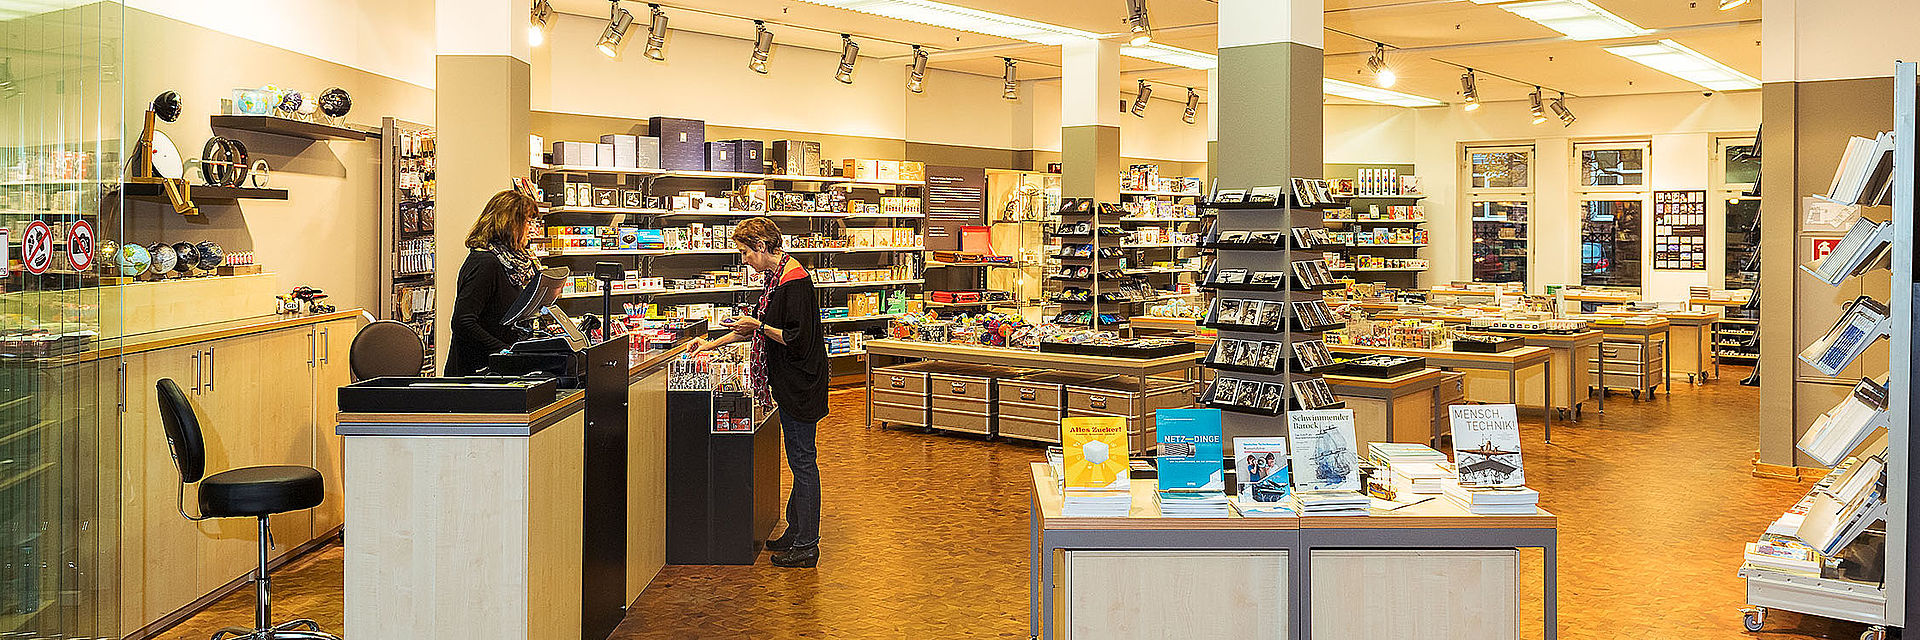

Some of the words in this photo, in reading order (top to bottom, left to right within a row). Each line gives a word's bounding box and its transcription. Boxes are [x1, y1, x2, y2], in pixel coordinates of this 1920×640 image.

[1292, 413, 1349, 422] Schwimmender
[1454, 408, 1503, 419] MENSCH,
[1293, 422, 1319, 430] Barock
[1466, 420, 1515, 431] TECHNIK!
